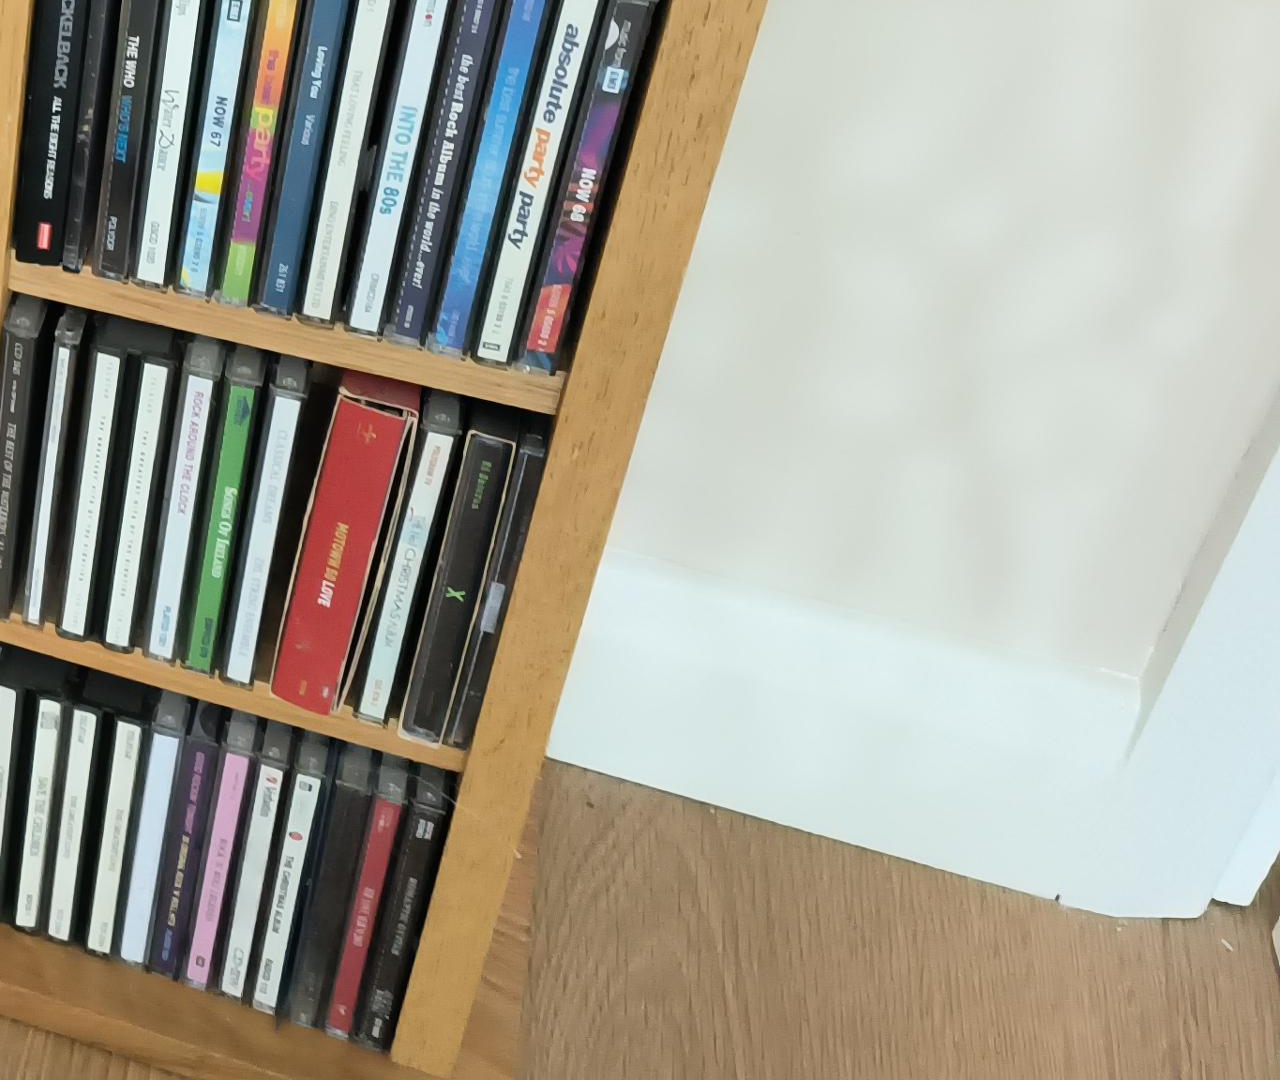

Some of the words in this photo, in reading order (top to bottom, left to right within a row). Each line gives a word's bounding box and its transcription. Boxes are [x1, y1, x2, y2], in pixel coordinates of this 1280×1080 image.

[124, 34, 139, 58] THE
[309, 45, 328, 79] Loving
[121, 59, 137, 88] WHO
[456, 53, 475, 75] the
[540, 21, 583, 126] absolute
[51, 95, 63, 113] ALL
[307, 78, 322, 99] You
[450, 74, 470, 102] best
[49, 114, 61, 132] THE
[116, 94, 133, 132] WHO'S
[210, 95, 229, 129] NOW
[392, 104, 419, 147] INTO
[442, 100, 464, 139] Rock
[46, 132, 59, 157] RIGHT
[207, 129, 223, 148] 67
[243, 106, 277, 180] party
[299, 113, 316, 146] Various
[113, 132, 128, 163] NEXT
[432, 139, 457, 187] Album
[520, 126, 555, 189] party
[42, 158, 57, 199] REASONS
[384, 148, 410, 184] THE
[377, 185, 401, 216] 80s
[430, 187, 446, 200] in
[573, 166, 598, 203] NOW
[425, 199, 444, 220] the
[504, 190, 539, 251] party
[276, 262, 290, 279] 261
[189, 390, 205, 419] ROCK
[5, 422, 17, 439] THE
[183, 419, 200, 461] AROUND
[2, 439, 15, 460] BEST
[267, 428, 288, 481] CLASSICAL
[0, 472, 12, 489] THE
[1, 460, 13, 472] OF
[132, 450, 146, 495] GREATEST
[180, 462, 194, 482] THE
[175, 482, 191, 515] CLOCK
[219, 485, 238, 520] SONGS
[326, 521, 349, 568] MOTOWN
[316, 579, 336, 608] LOVE
[388, 546, 418, 620] CHRISTMAS
[35, 775, 48, 796] SAVE
[274, 869, 292, 909] CHRISTMAS
